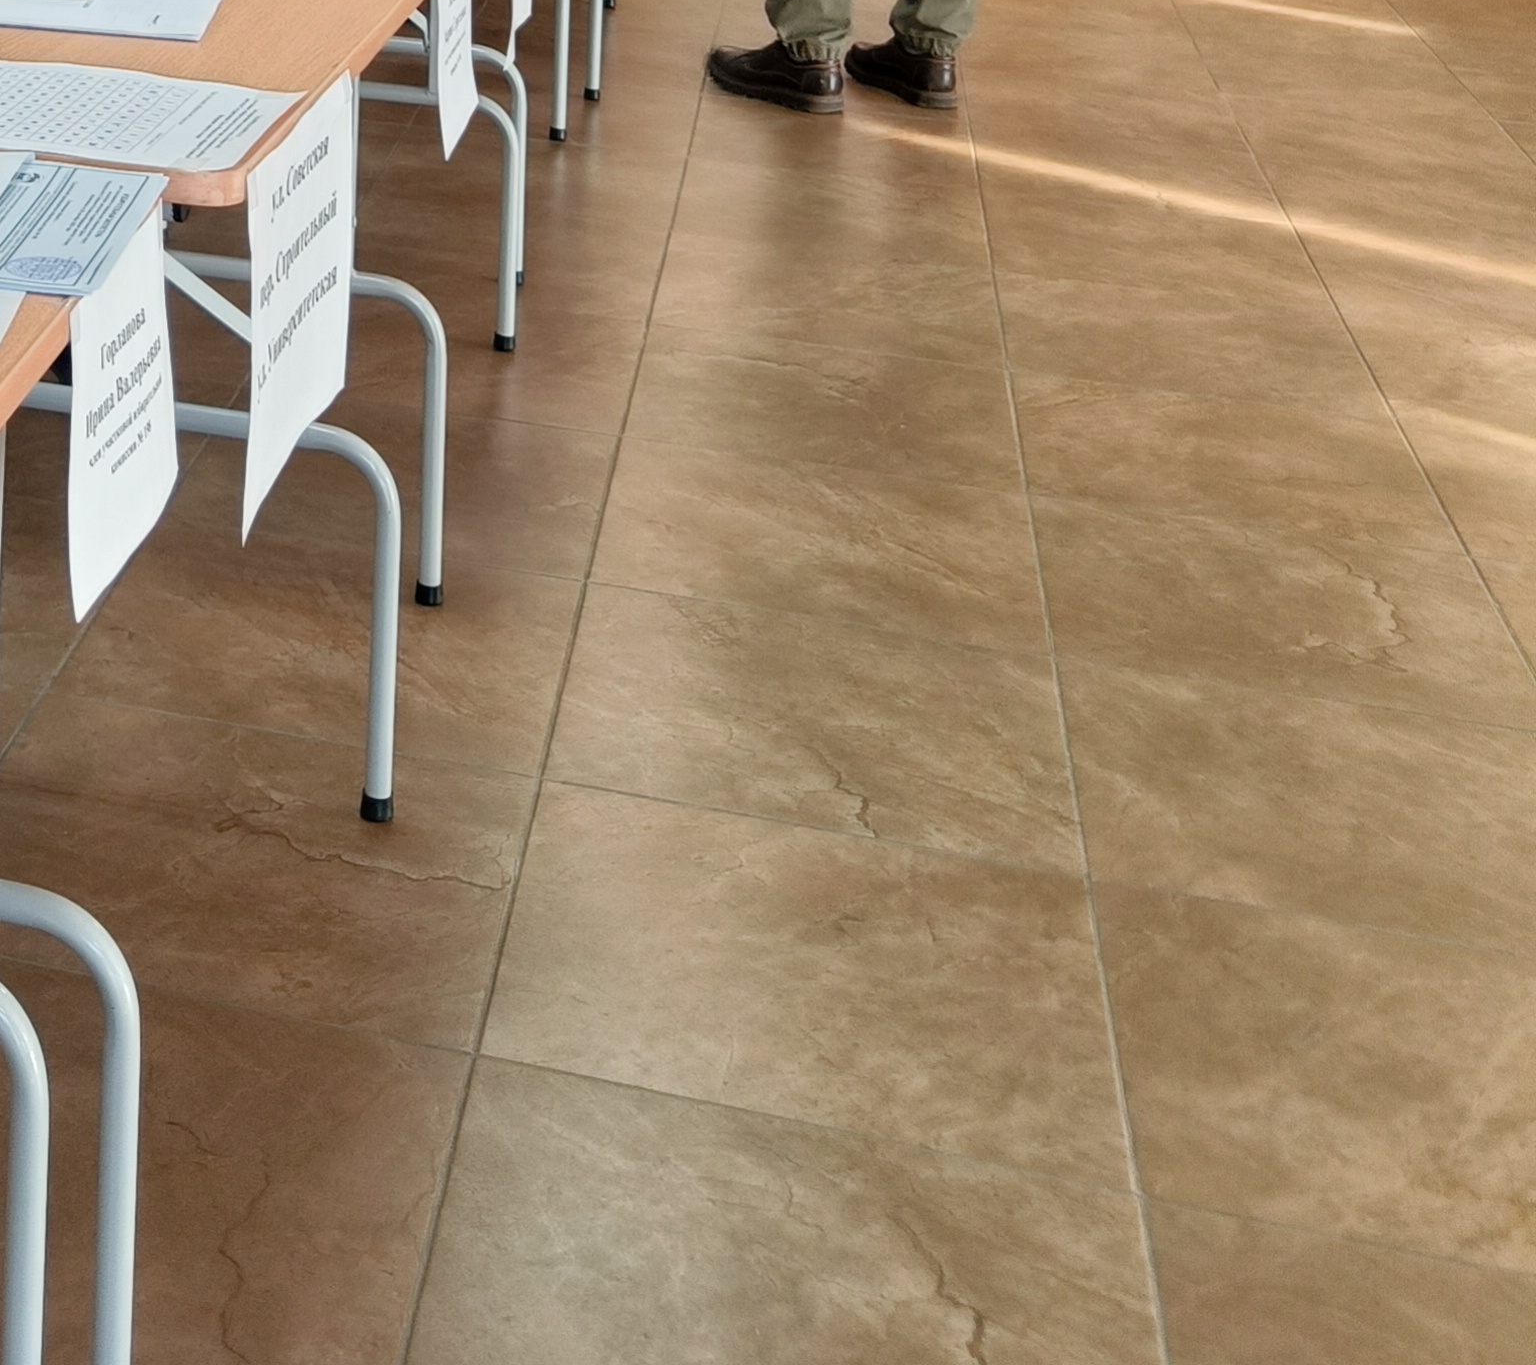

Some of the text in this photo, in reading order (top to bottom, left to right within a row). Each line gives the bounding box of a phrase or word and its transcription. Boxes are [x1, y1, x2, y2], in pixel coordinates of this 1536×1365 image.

[286, 135, 330, 197] Советская
[275, 190, 337, 283] Строительный
[100, 307, 146, 370] Горланова
[267, 265, 338, 369] Университетская
[85, 335, 162, 439] Ирина Валерьевна
